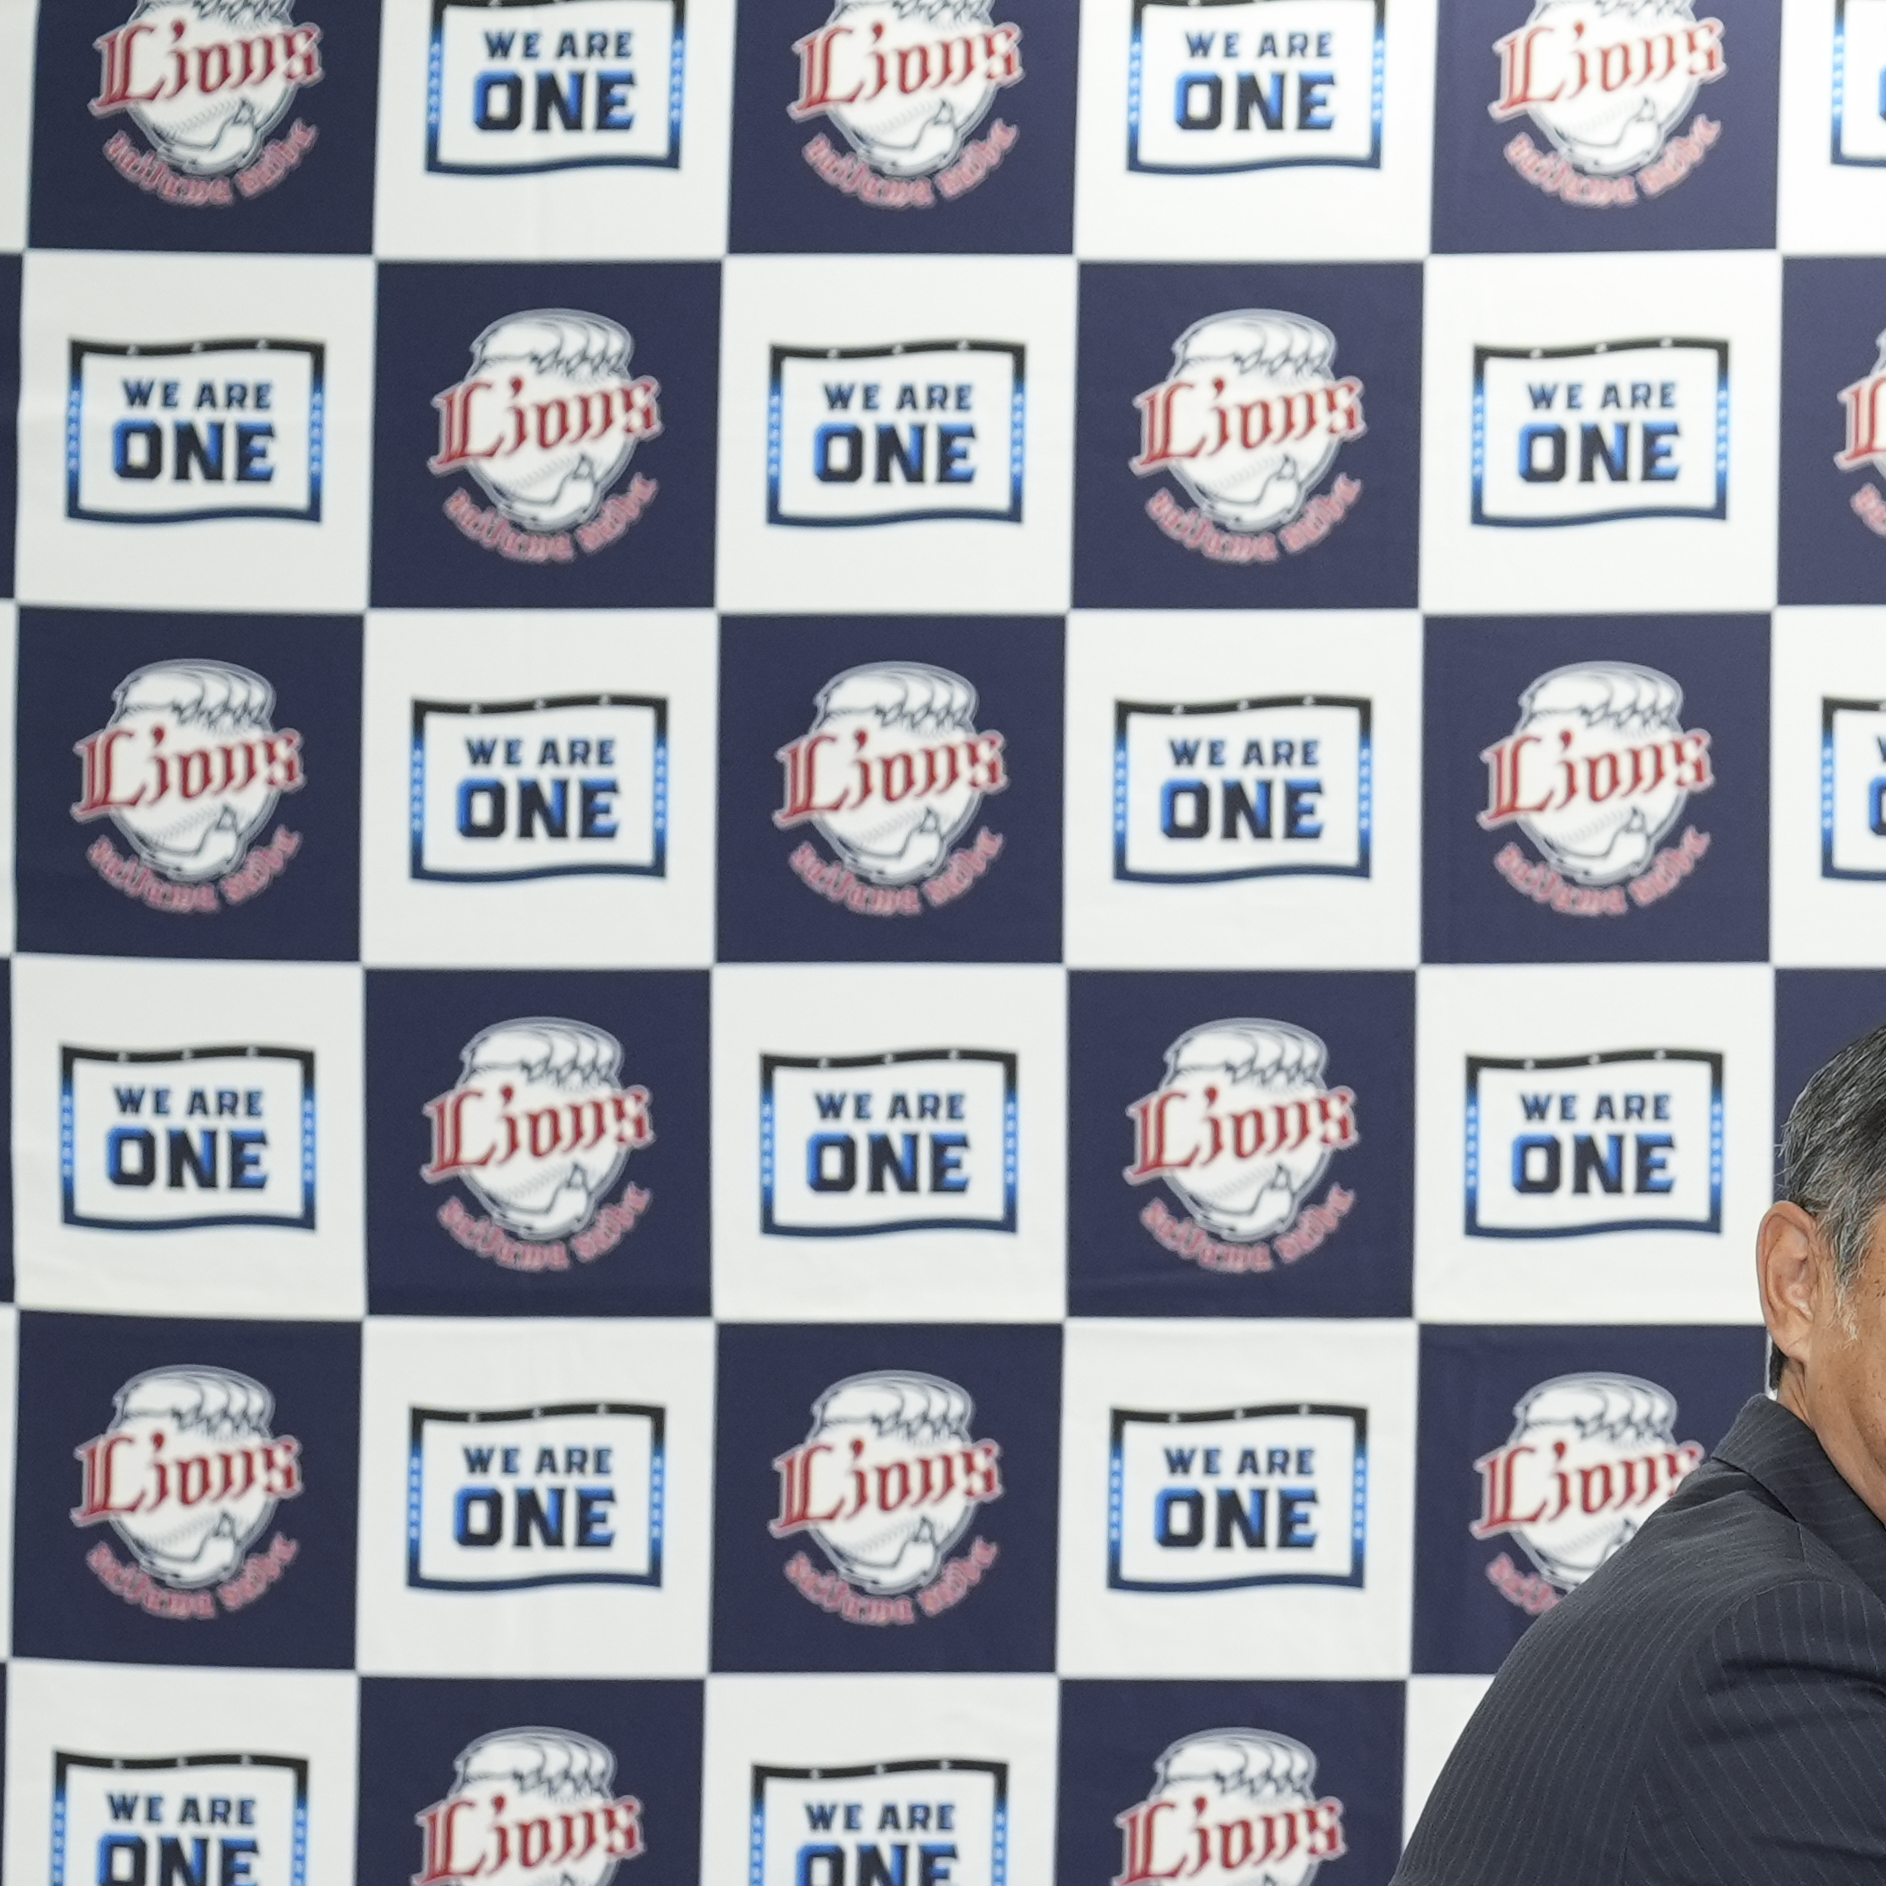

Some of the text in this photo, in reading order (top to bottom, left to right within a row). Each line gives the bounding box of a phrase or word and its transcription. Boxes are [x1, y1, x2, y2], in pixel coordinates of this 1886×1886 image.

[98, 20, 319, 107] Lions
[796, 22, 1019, 112] Lions
[1186, 32, 1331, 58] WE ARE
[1498, 22, 1721, 112] Lions
[1175, 72, 1335, 131] ONE
[123, 380, 271, 411] WE ARE
[436, 376, 656, 466] Lions
[824, 384, 972, 412] WE ARE
[1138, 377, 1360, 467] Lions
[113, 420, 275, 483] ONE
[814, 423, 976, 484] ONE
[79, 725, 300, 812] Lions
[781, 729, 1003, 820] Lions
[1487, 730, 1709, 821] Lions
[114, 1087, 262, 1118] WE ARE
[429, 1085, 649, 1174] Lions
[815, 1092, 964, 1121] WE ARE
[1133, 1086, 1354, 1177] Lions
[1520, 1094, 1670, 1122] WE ARE
[107, 1127, 268, 1190] ONE
[807, 1133, 970, 1194] ONE
[1512, 1134, 1675, 1195] ONE
[82, 1432, 298, 1518] Lions
[778, 1438, 999, 1529] Lions
[107, 1794, 256, 1826] WE ARE
[420, 1794, 640, 1885] Lions
[805, 1803, 955, 1832] WE ARE
[1120, 1796, 1342, 1886] Lions
